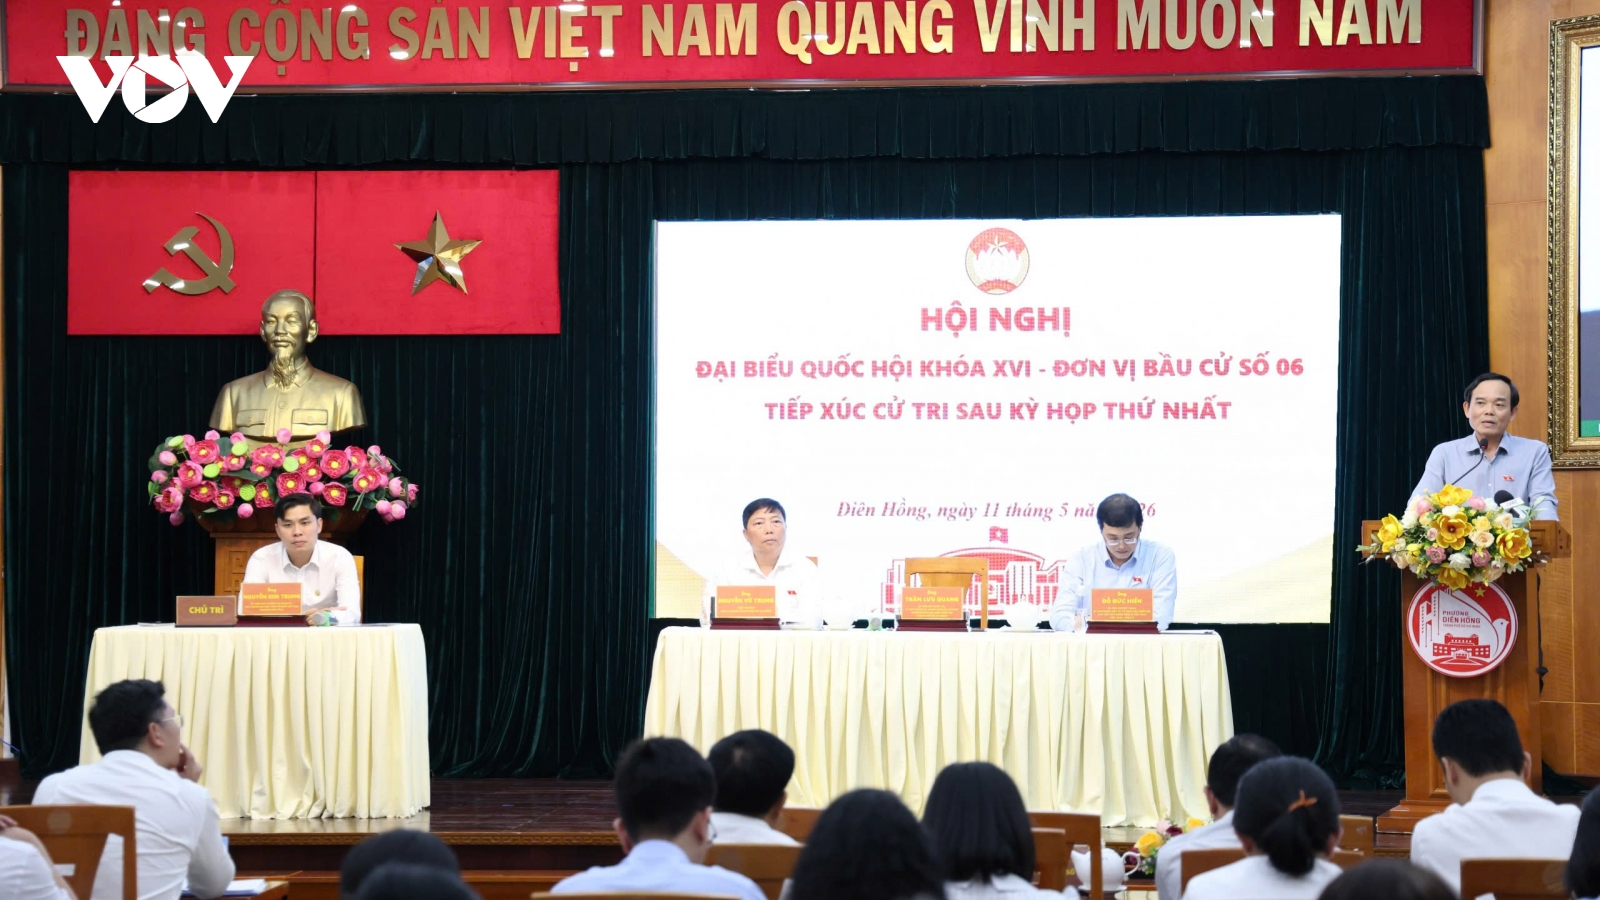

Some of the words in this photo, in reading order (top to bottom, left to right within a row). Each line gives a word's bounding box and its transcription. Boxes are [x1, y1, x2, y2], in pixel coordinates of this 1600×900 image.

[642, 3, 758, 57] NAM
[777, 0, 954, 65] QUANG
[973, 0, 1096, 52] VINH
[920, 300, 978, 338] HỘI
[989, 307, 1071, 338] NGHỊ
[695, 360, 736, 382] ĐẠI
[744, 352, 794, 378] BIỂU
[800, 353, 865, 379] QUỐC
[871, 354, 912, 382] HỘI
[920, 354, 986, 378] KHÓA
[993, 360, 1031, 377] XVI
[1052, 358, 1106, 377] ĐƠN
[1113, 359, 1136, 381] VỊ
[1143, 352, 1192, 377] BẦU
[1199, 351, 1233, 376] CỬ
[1239, 351, 1270, 376] SỐ
[1276, 358, 1304, 376] 06
[764, 395, 813, 420] TIẾP
[820, 397, 866, 420] XÚC
[872, 396, 906, 420] CỬ
[912, 402, 949, 420] TRI
[956, 402, 1002, 420] SAU
[1010, 397, 1039, 420] KỲ
[1047, 402, 1098, 424] HỌP
[1103, 396, 1156, 420] THỨ
[1163, 395, 1232, 420] NHẤT
[837, 501, 876, 517] Diên
[881, 497, 931, 521] Hồng,
[937, 502, 977, 522] ngày
[983, 502, 1000, 517] 11
[1006, 502, 1053, 522] tháng
[1059, 503, 1069, 517] 5
[1074, 503, 1096, 517] nă
[189, 604, 208, 614] CHỦ
[210, 604, 225, 614] TRÌ
